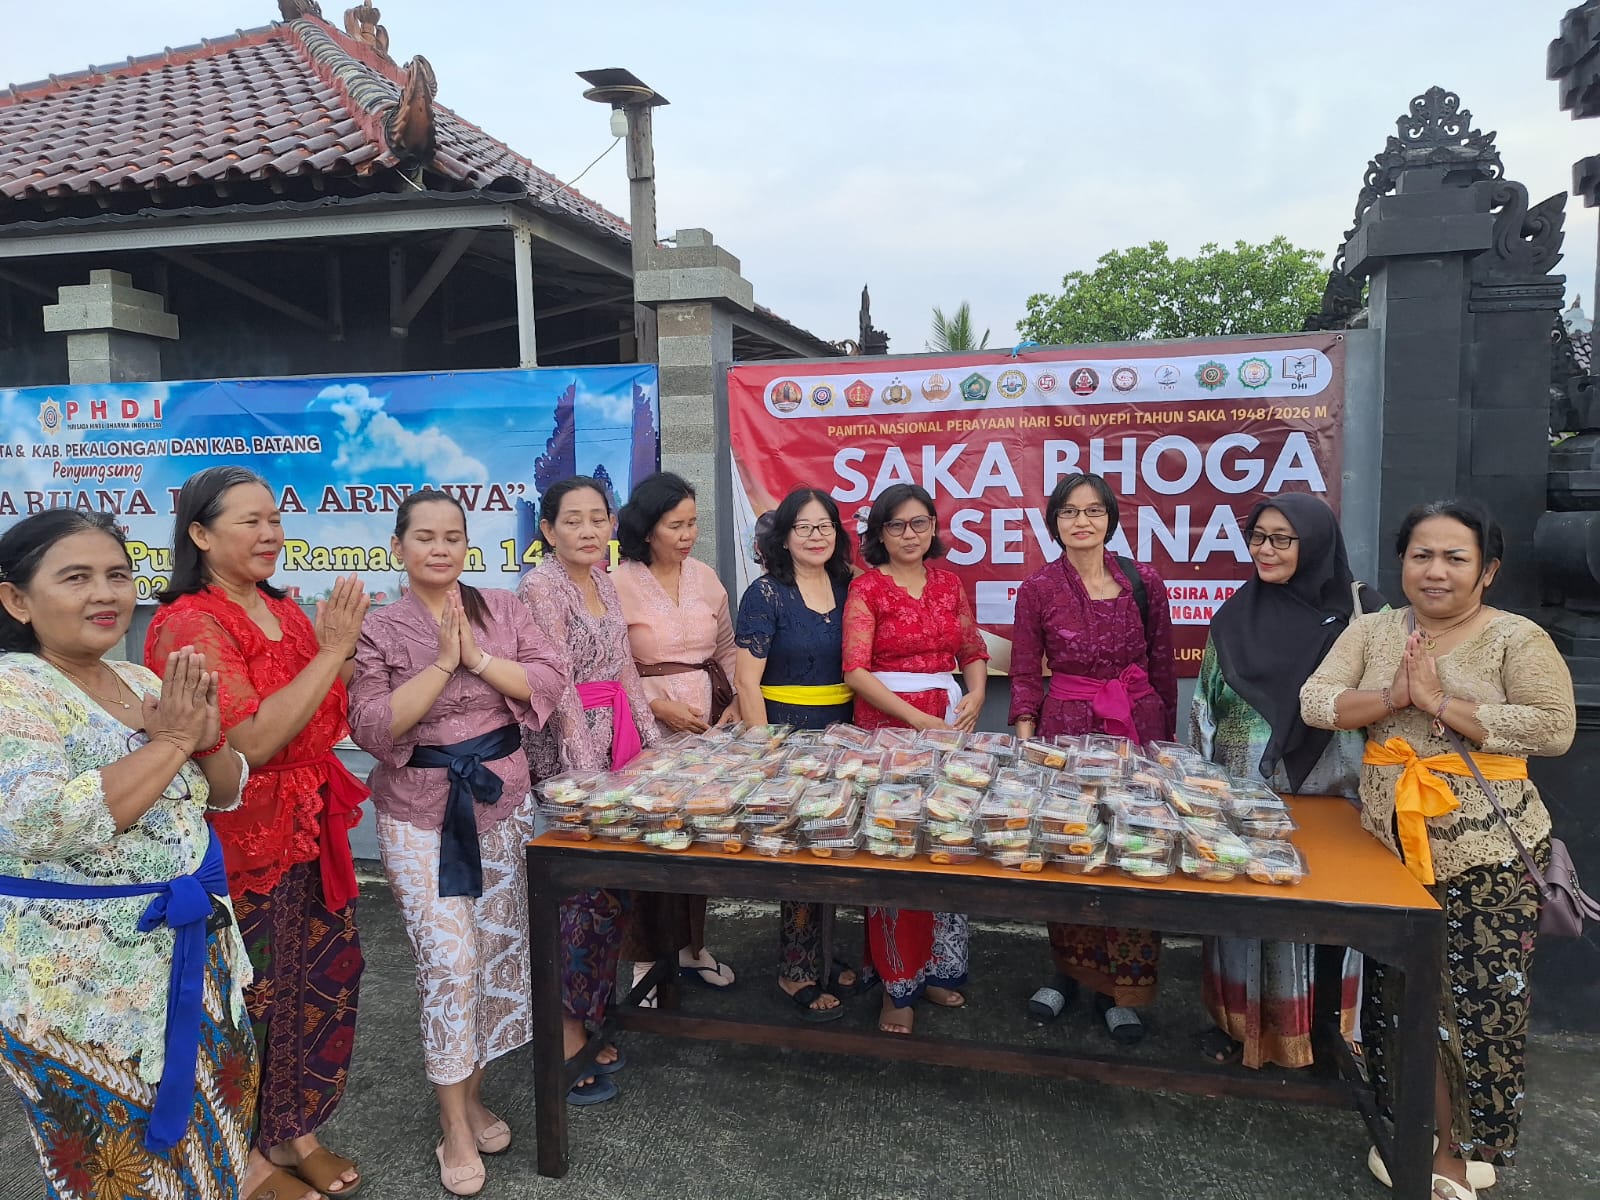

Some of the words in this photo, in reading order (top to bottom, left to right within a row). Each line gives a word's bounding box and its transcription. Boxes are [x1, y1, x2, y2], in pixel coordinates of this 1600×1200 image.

[827, 423, 876, 437] PANITIA
[879, 420, 943, 435] NASIONAL
[947, 417, 1015, 432] PERAYAAN
[1019, 415, 1051, 428] HARI
[1054, 414, 1086, 427] SUCI
[1089, 412, 1131, 426] NYEPI
[1135, 411, 1184, 424] TAHUN
[1188, 409, 1226, 423] SAKA
[1231, 406, 1311, 422] 1948/2026
[1314, 405, 1327, 418] M
[16, 444, 26, 457] &
[32, 444, 62, 458] KAB.
[66, 441, 166, 458] PEKALONGAN
[171, 439, 207, 455] DAN
[212, 438, 250, 454] KAB.
[253, 436, 320, 453] BATANG
[53, 461, 142, 483] Penyungsung
[830, 441, 1024, 503] SAKA
[24, 489, 156, 515] BUANA
